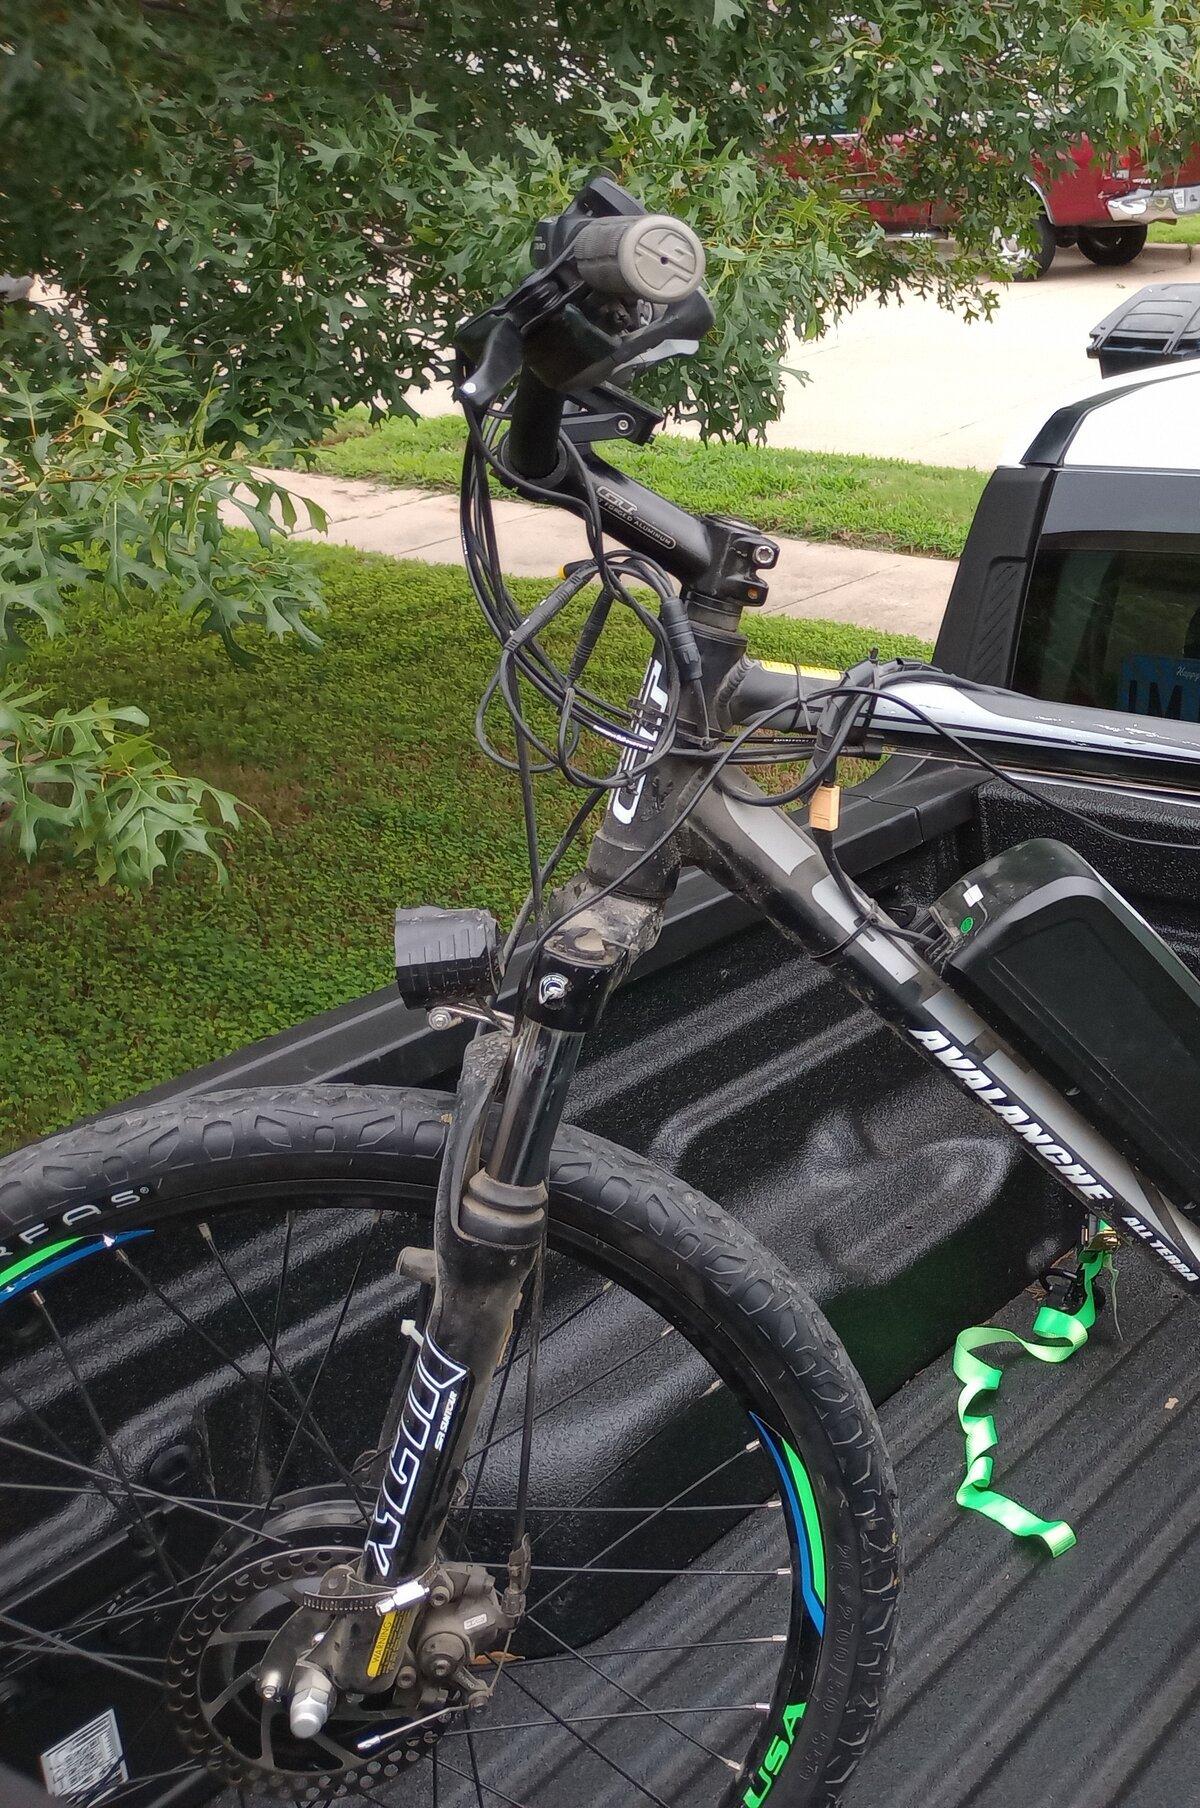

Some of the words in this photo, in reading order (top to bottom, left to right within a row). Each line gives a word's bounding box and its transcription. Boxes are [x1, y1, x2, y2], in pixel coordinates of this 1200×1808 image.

[634, 521, 671, 545] ALUMINUM
[1176, 664, 1200, 682] Happy
[908, 1029, 1113, 1200] AVALANCHE
[1121, 1215, 1153, 1239] ALL
[1150, 1240, 1200, 1282] TERRA
[441, 1390, 458, 1434] SUNTOUR
[371, 1620, 392, 1664] WARNING
[742, 1702, 807, 1808] USA
